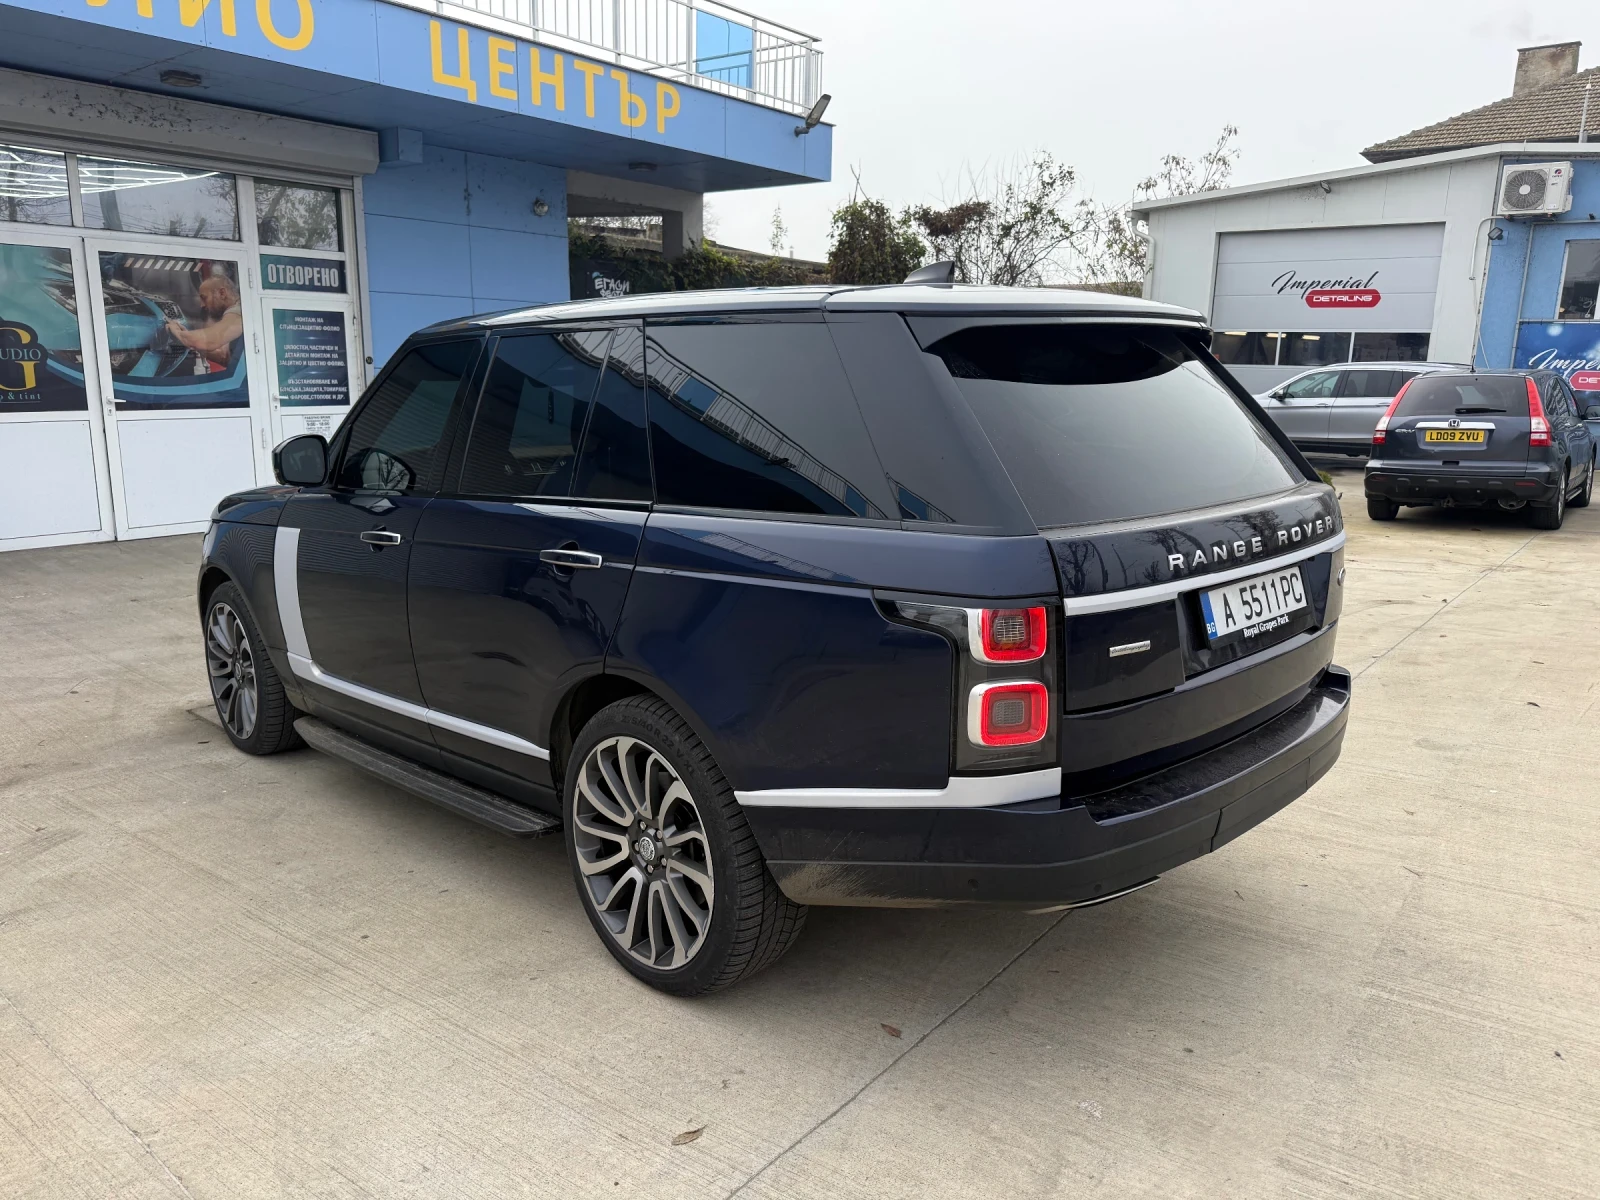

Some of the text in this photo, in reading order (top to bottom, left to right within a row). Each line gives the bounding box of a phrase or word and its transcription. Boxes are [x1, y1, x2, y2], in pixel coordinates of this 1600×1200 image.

[429, 19, 681, 134] ЦЕНТЪР
[267, 263, 339, 288] ОТВОРЕНО
[1271, 270, 1380, 300] Imperial
[1312, 295, 1373, 303] DETAILING
[19, 391, 41, 400] tint
[1429, 432, 1480, 441] LD09 ZVU
[1168, 515, 1333, 571] RANGE ROVER
[1222, 592, 1236, 628] A
[1206, 622, 1216, 634] BG
[1243, 613, 1290, 638] Royal Grapes Park
